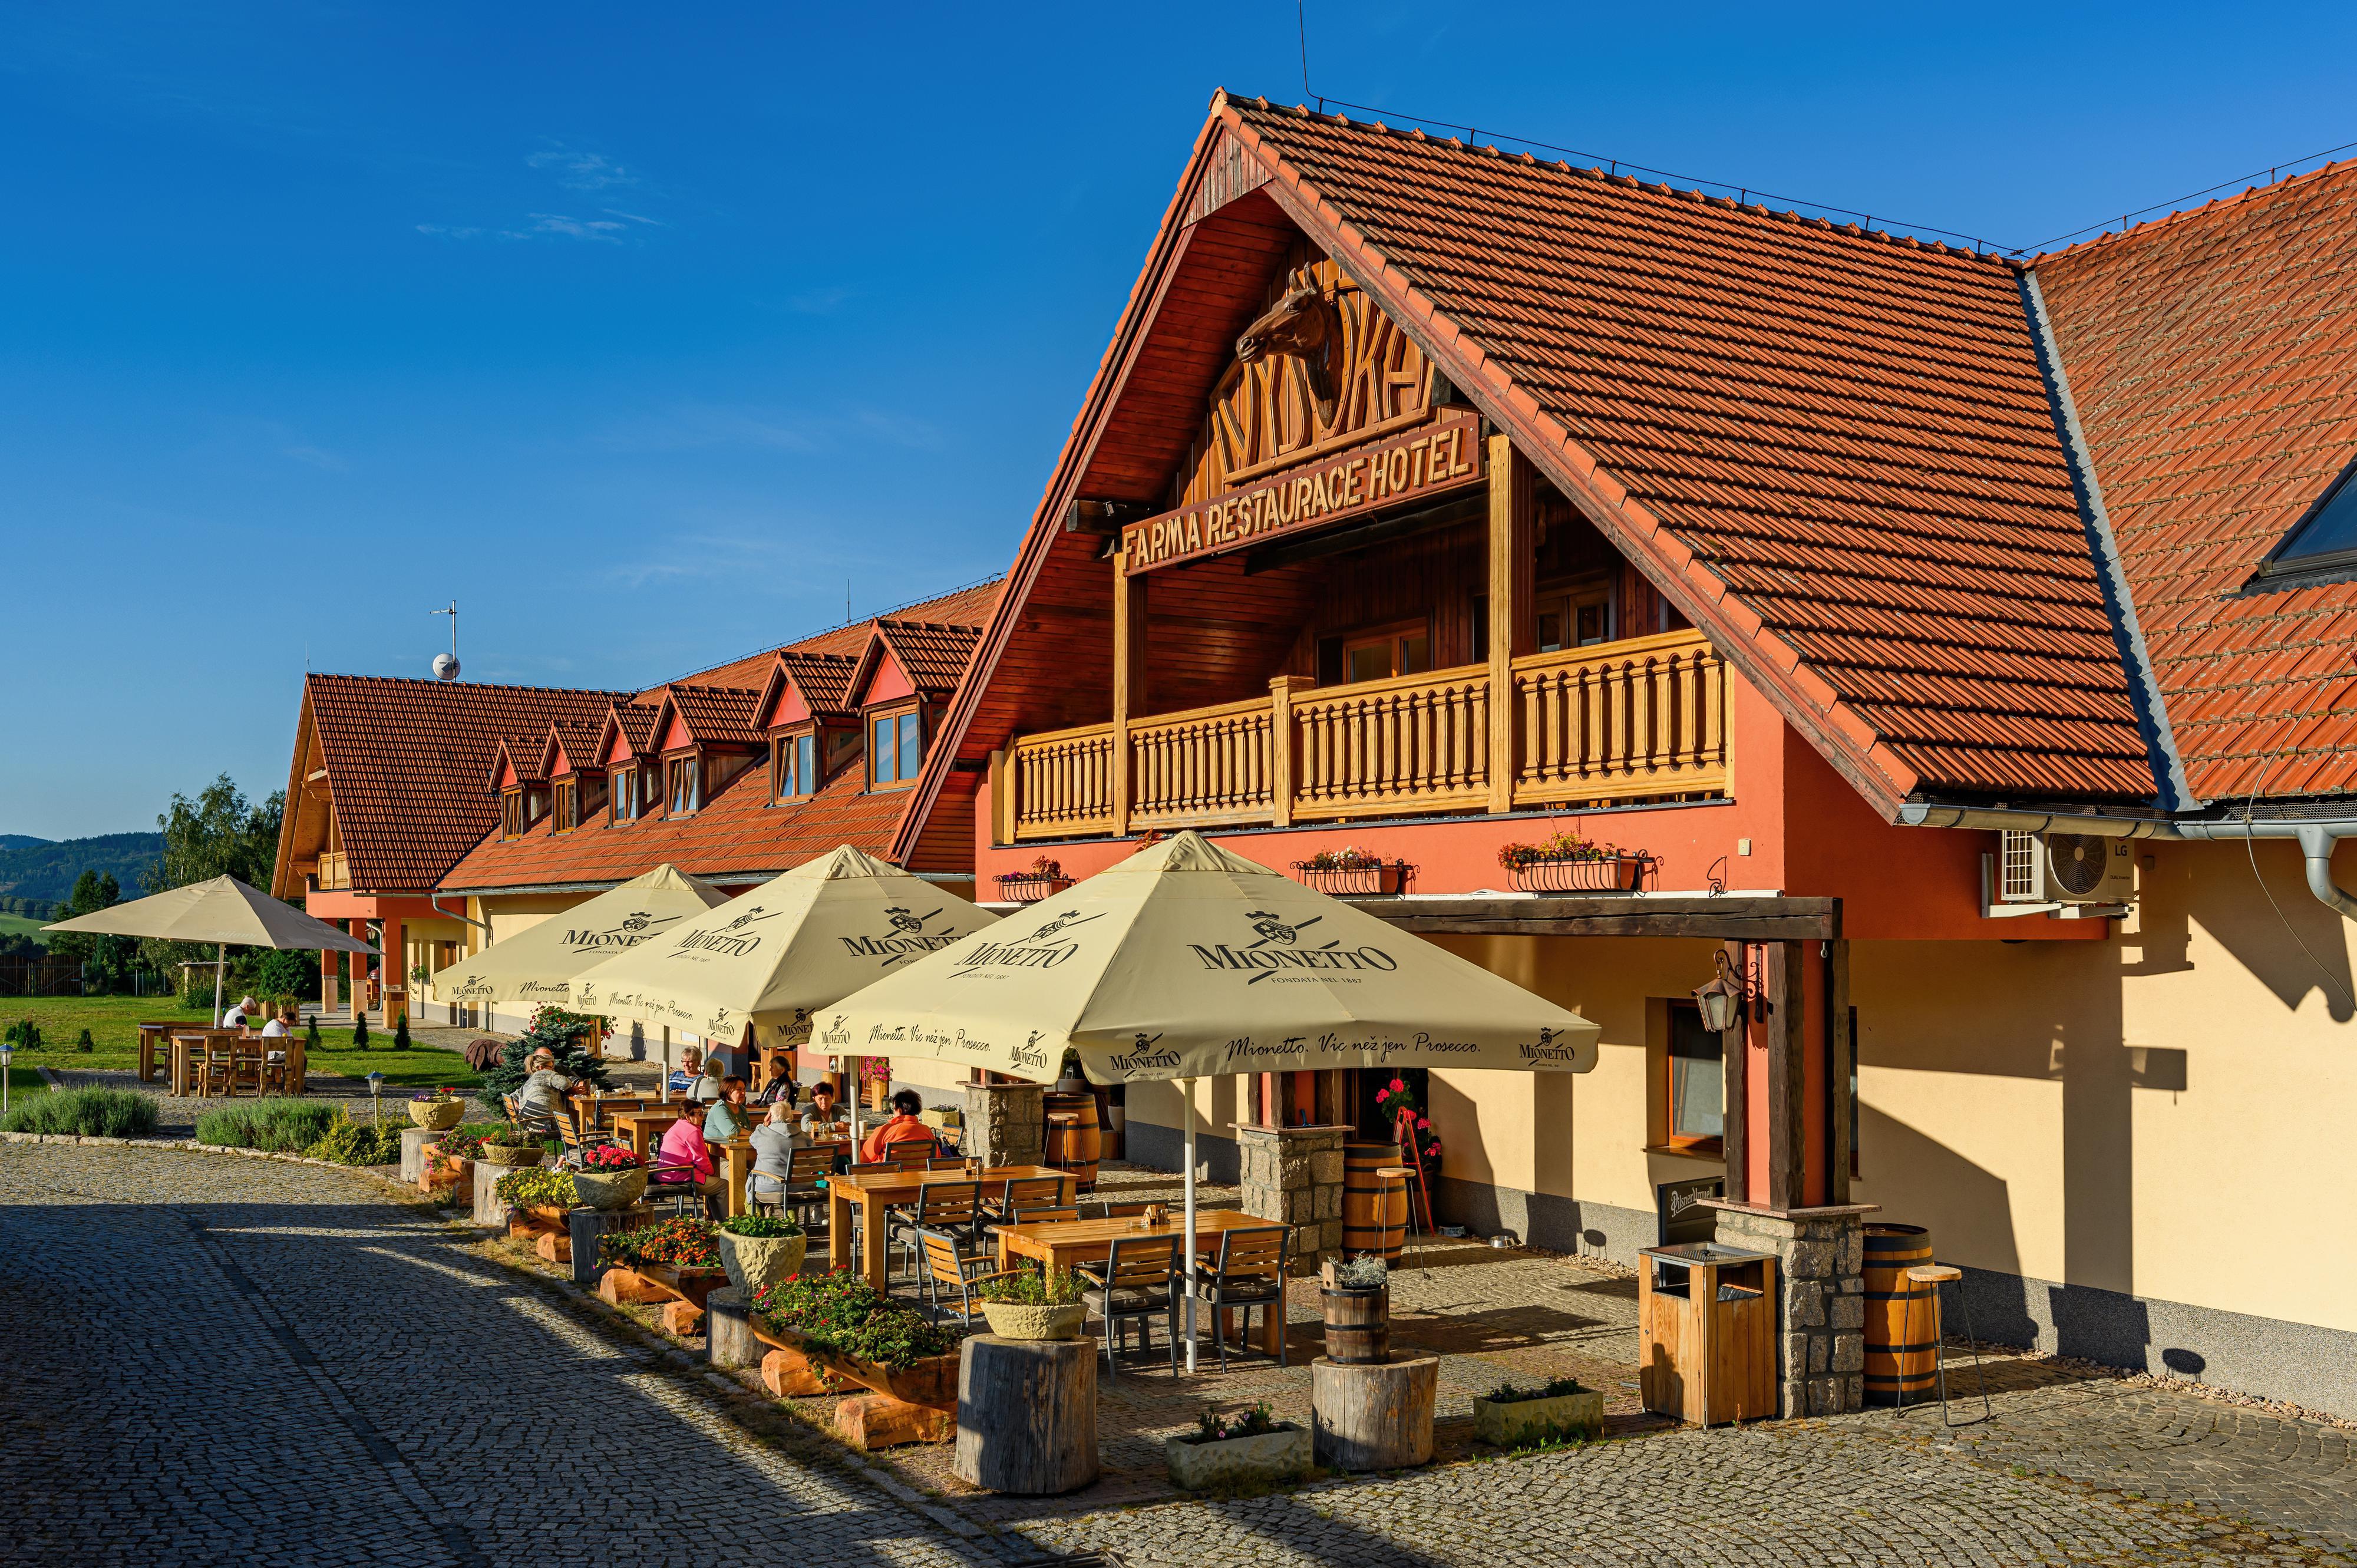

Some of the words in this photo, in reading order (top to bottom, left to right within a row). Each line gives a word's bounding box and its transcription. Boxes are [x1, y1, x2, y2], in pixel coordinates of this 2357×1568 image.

[1122, 511, 1203, 570] FARMA
[1206, 457, 1368, 546] RESTAURACE
[1368, 427, 1473, 500] HOTEL
[2115, 844, 2127, 856] LG
[673, 929, 761, 956] MIONETTO
[838, 931, 978, 956] MIONET
[953, 943, 1079, 968] MIONETTO
[1186, 944, 1398, 971] MIONETTO
[451, 986, 493, 995] MIONETTO
[577, 995, 597, 1006] MIONETTO
[653, 999, 665, 1018] jen
[667, 1000, 694, 1021] Prosecco.
[708, 1018, 735, 1036] MIONETTO
[821, 1031, 850, 1044] MIONETTO
[926, 1029, 937, 1044] než
[936, 1030, 952, 1057] jen
[955, 1028, 991, 1052] Prosecco.
[1224, 1036, 1309, 1061] Mionetto.
[1318, 1032, 1347, 1052] Víc
[1351, 1036, 1378, 1051] než
[1381, 1035, 1407, 1063] jen
[1412, 1032, 1481, 1052] Prosecco.
[1518, 1044, 1575, 1061] MIONETTO
[1008, 1046, 1047, 1068] MIONETTO
[1108, 1051, 1181, 1071] MIONETTO
[1671, 1190, 1694, 1218] Pilsner
